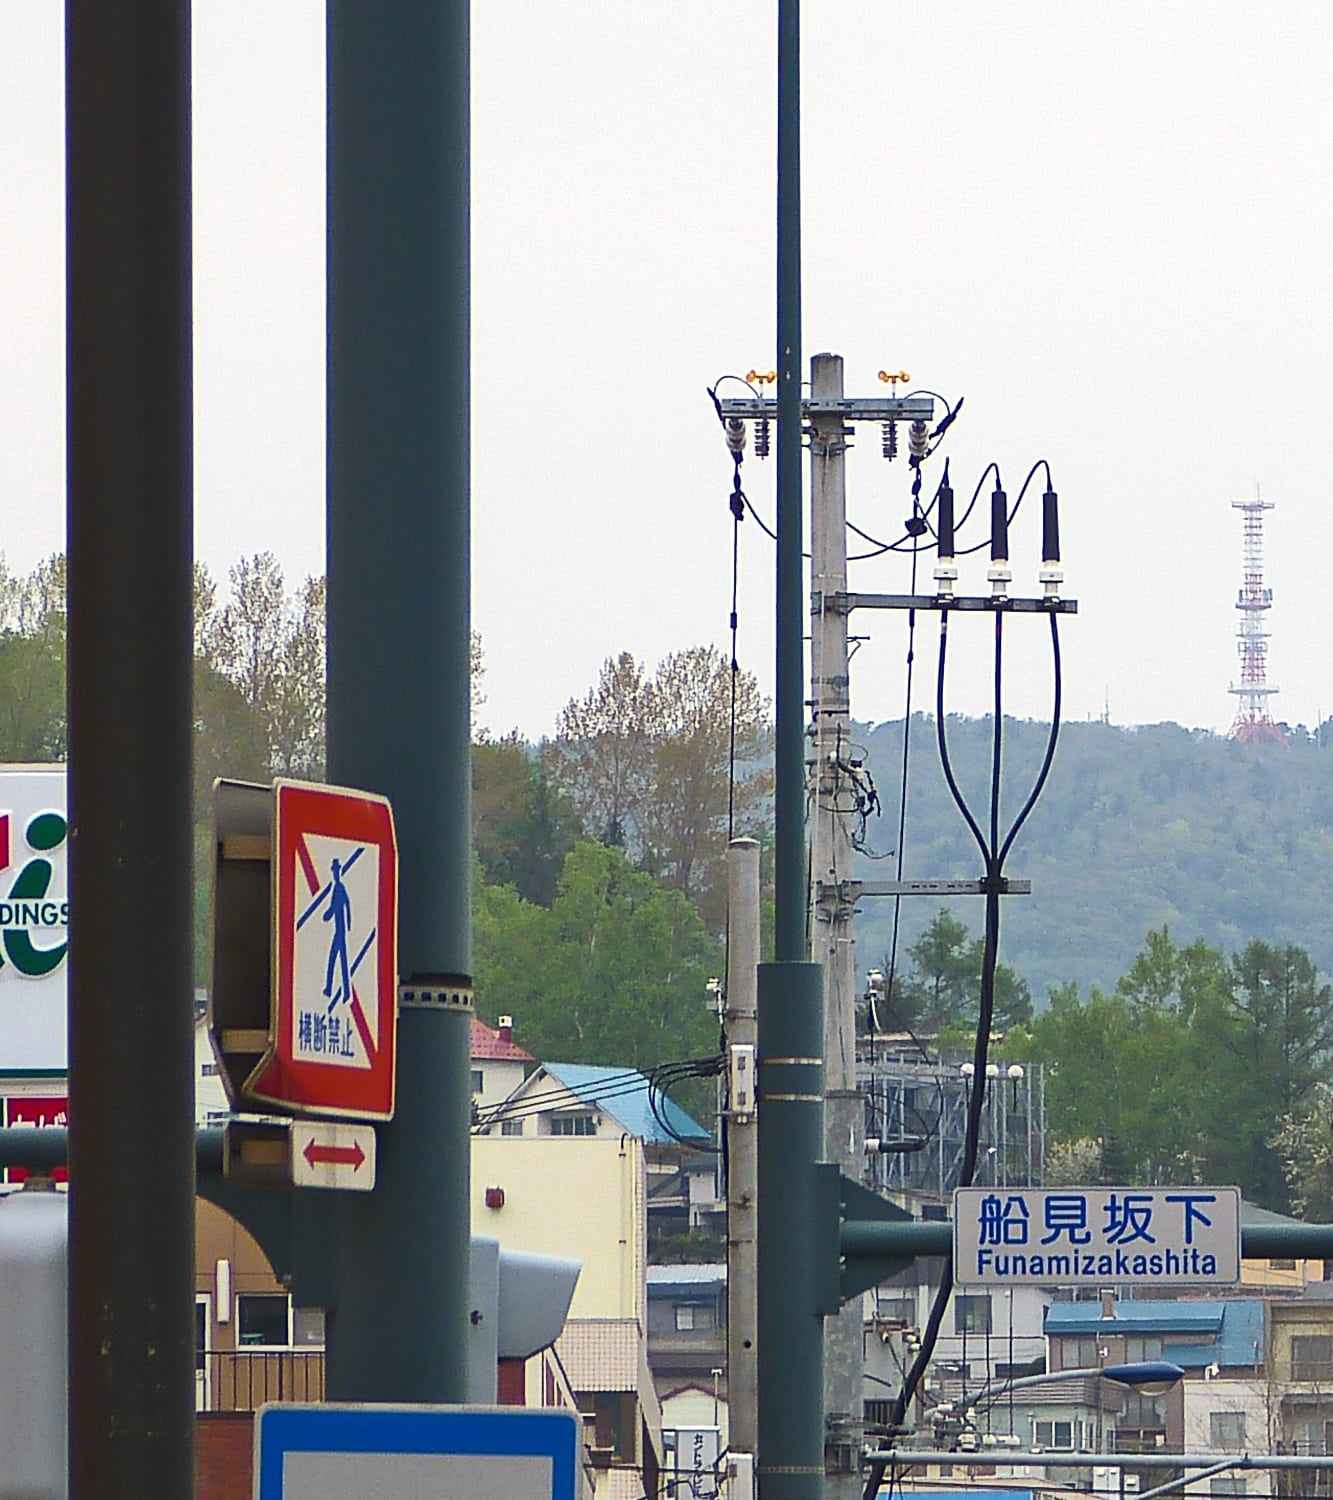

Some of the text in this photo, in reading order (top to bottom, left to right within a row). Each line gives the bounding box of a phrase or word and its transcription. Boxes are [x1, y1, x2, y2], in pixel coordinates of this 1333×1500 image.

[0, 903, 68, 927] DINGS
[299, 1011, 354, 1057] 横断禁止
[978, 1194, 1217, 1245] 船見坂下
[978, 1249, 1217, 1276] Funamizakashita
